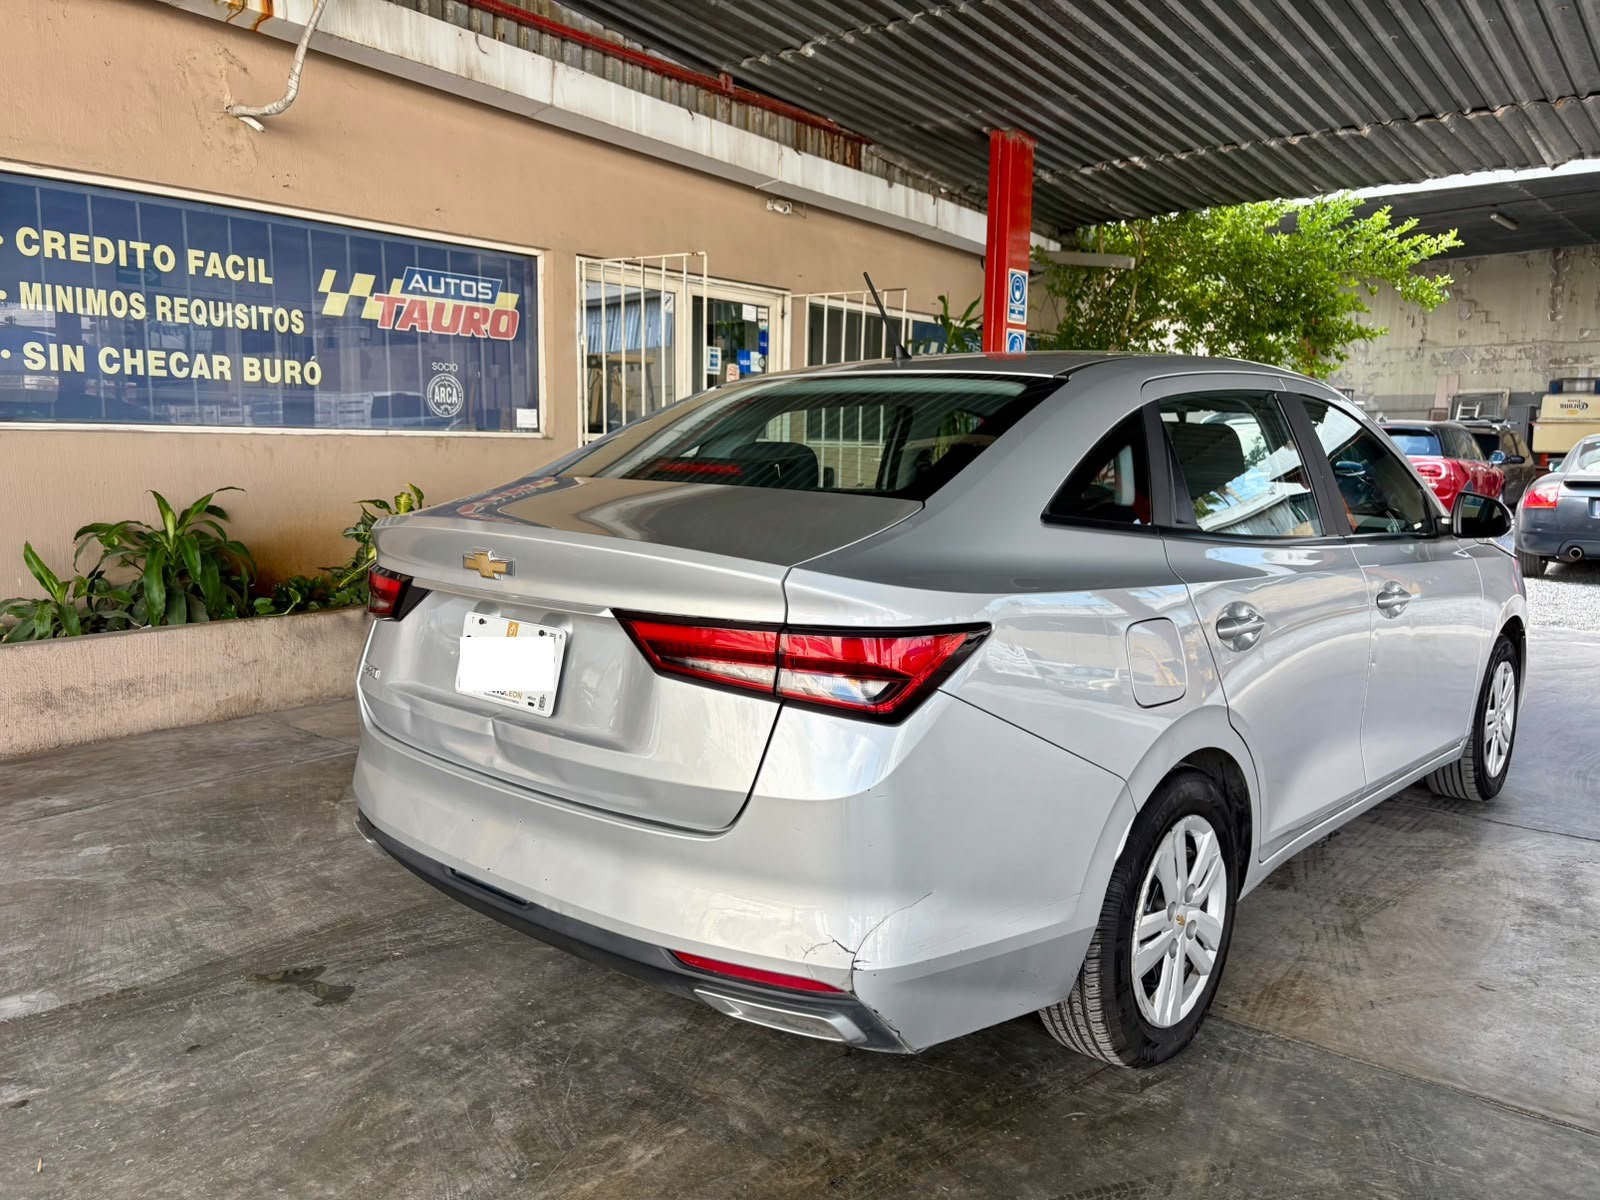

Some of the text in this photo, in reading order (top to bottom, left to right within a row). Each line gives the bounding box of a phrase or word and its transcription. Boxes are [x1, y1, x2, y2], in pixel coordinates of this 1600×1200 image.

[15, 226, 273, 285] CREDITO FACIL
[19, 281, 305, 335] MINIMOS REQUISITOS
[407, 273, 493, 300] AUTOS
[374, 293, 519, 340] TAURO
[23, 341, 322, 386] SIN CHECAR BURÓ
[432, 362, 458, 371] SOCIO
[434, 386, 458, 404] ARCA
